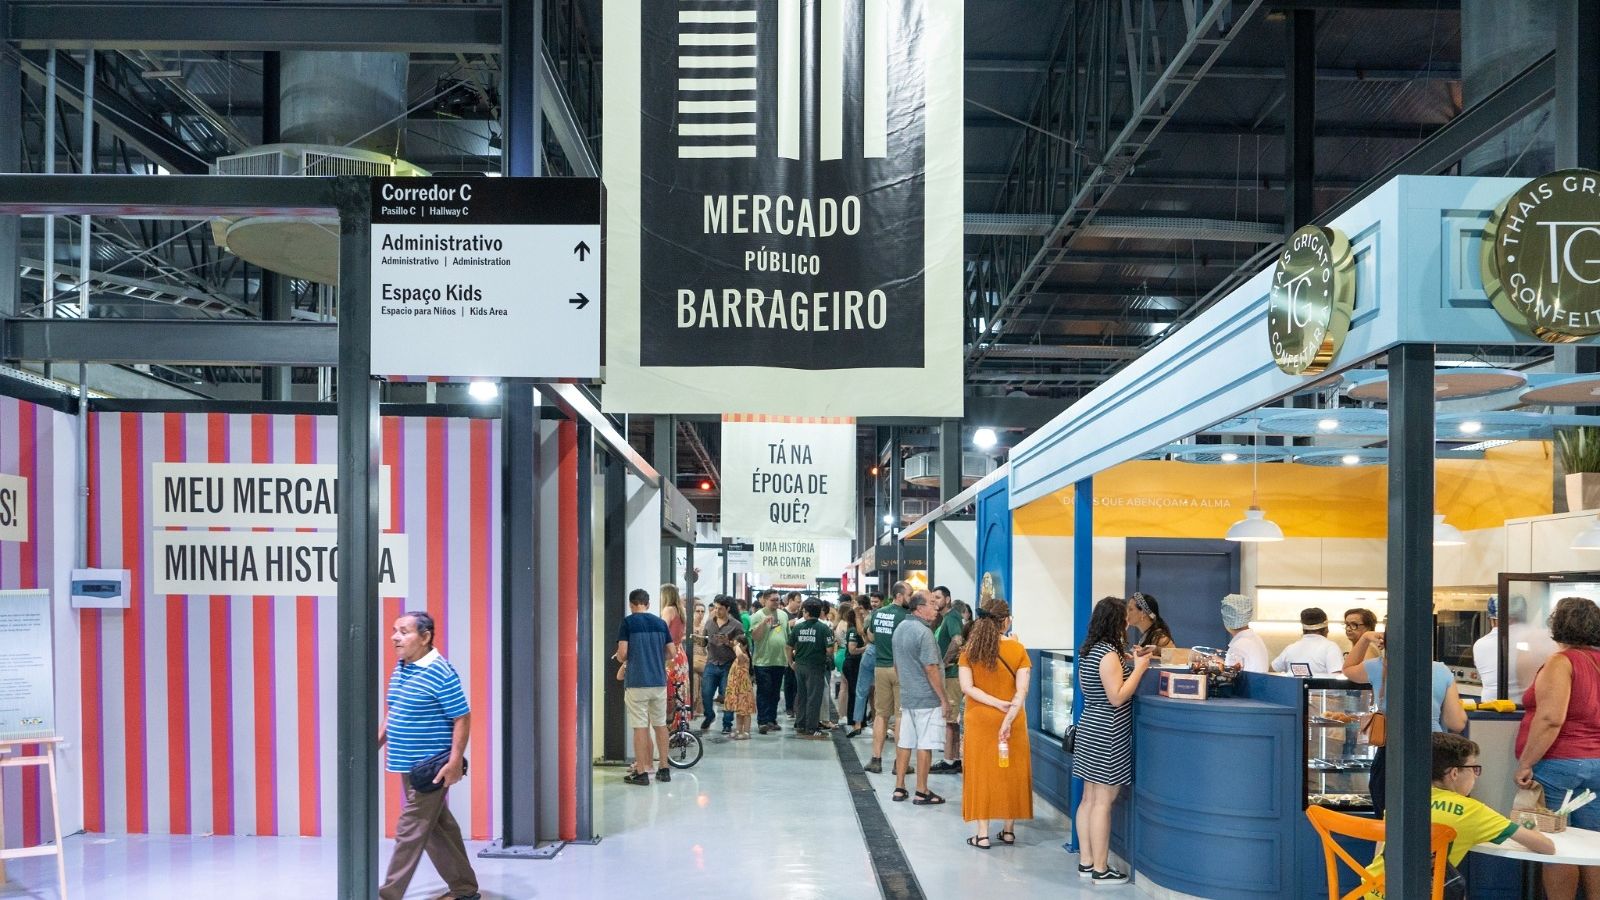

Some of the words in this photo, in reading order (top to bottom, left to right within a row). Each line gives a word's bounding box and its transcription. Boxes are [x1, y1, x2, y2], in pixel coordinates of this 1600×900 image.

[381, 183, 456, 201] Corredor
[459, 183, 472, 201] C
[381, 206, 408, 216] Pasillo
[409, 206, 417, 216] C
[429, 206, 461, 217] Hallway
[462, 207, 469, 216] C
[703, 195, 861, 238] MERCADO
[1502, 183, 1553, 246] THAIS
[1562, 176, 1600, 199] GR
[381, 233, 503, 251] Administrativo
[381, 257, 439, 266] Administrativo
[452, 257, 511, 266] Administration
[744, 246, 821, 276] PÚBLICO
[1270, 249, 1291, 313] THAIS
[1293, 233, 1330, 283] GRIGATO
[382, 283, 441, 305] Espaço
[446, 284, 483, 301] Kids
[381, 306, 413, 317] Espacio
[414, 308, 432, 317] para
[433, 307, 457, 316] Niños
[470, 307, 488, 316] Kids
[489, 307, 508, 316] Area
[677, 288, 888, 332] BARRAGEIRO
[768, 439, 787, 464] TÁ
[790, 444, 813, 464] NA
[752, 468, 804, 494] ÉPOCA
[808, 474, 828, 494] DE
[164, 476, 225, 514] MEU
[233, 477, 338, 515] MERCA
[1101, 497, 1124, 507] QUE
[1127, 497, 1187, 509] ABENÇOAM
[1190, 499, 1199, 508] A
[1200, 499, 1231, 508] ALMA
[769, 498, 810, 524] QUÊ?
[759, 541, 777, 553] UMA
[779, 540, 815, 554] HISTÓRIA
[164, 544, 258, 582] MINHA
[265, 541, 396, 584] HISTA
[762, 556, 778, 567] PRA
[780, 557, 811, 568] CONTAR
